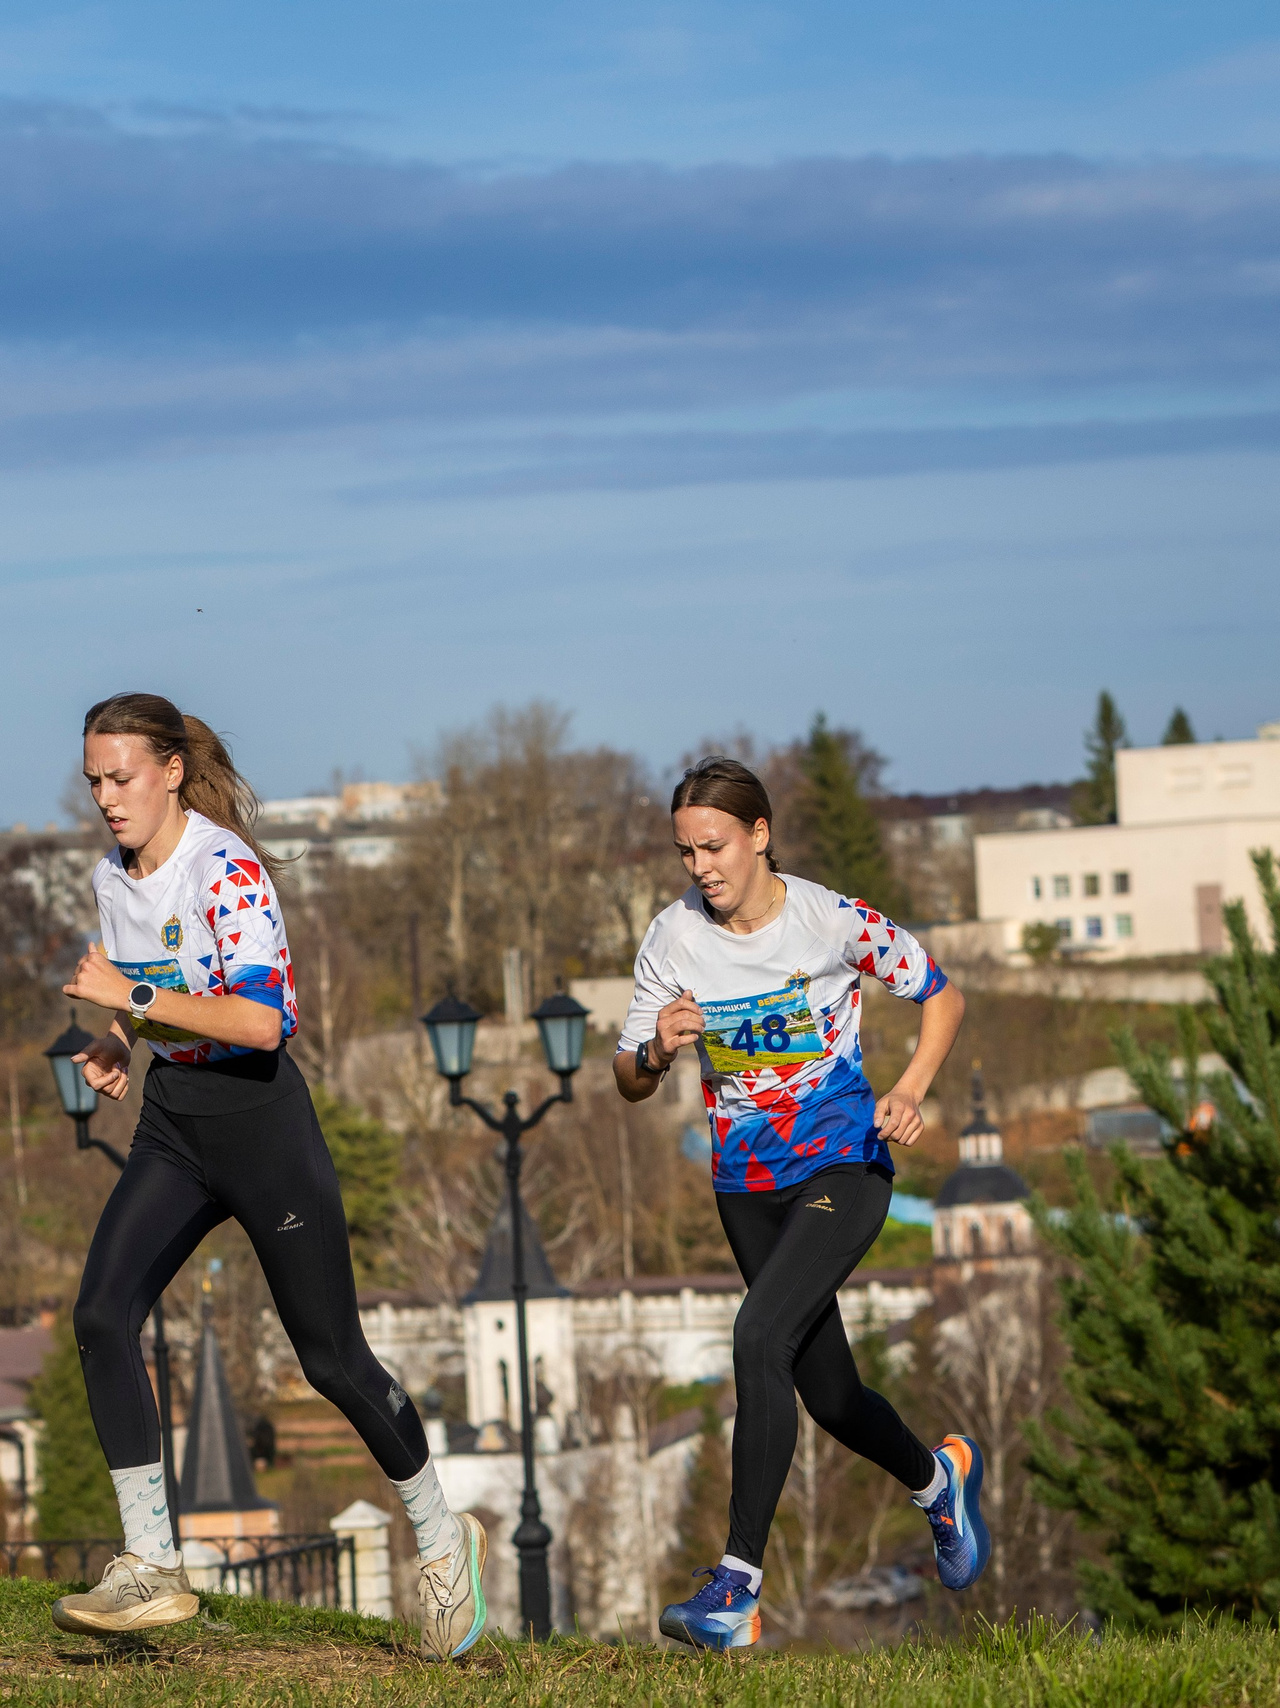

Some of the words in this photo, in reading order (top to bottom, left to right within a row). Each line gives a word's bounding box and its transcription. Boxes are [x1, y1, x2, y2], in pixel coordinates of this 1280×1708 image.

[142, 964, 176, 976] ВЕРСТЫ
[702, 1003, 751, 1014] СТАРИЦКИЕ
[757, 992, 797, 1007] ВЕРСТЫ
[731, 1014, 791, 1056] 48
[277, 1221, 304, 1231] DEMIX
